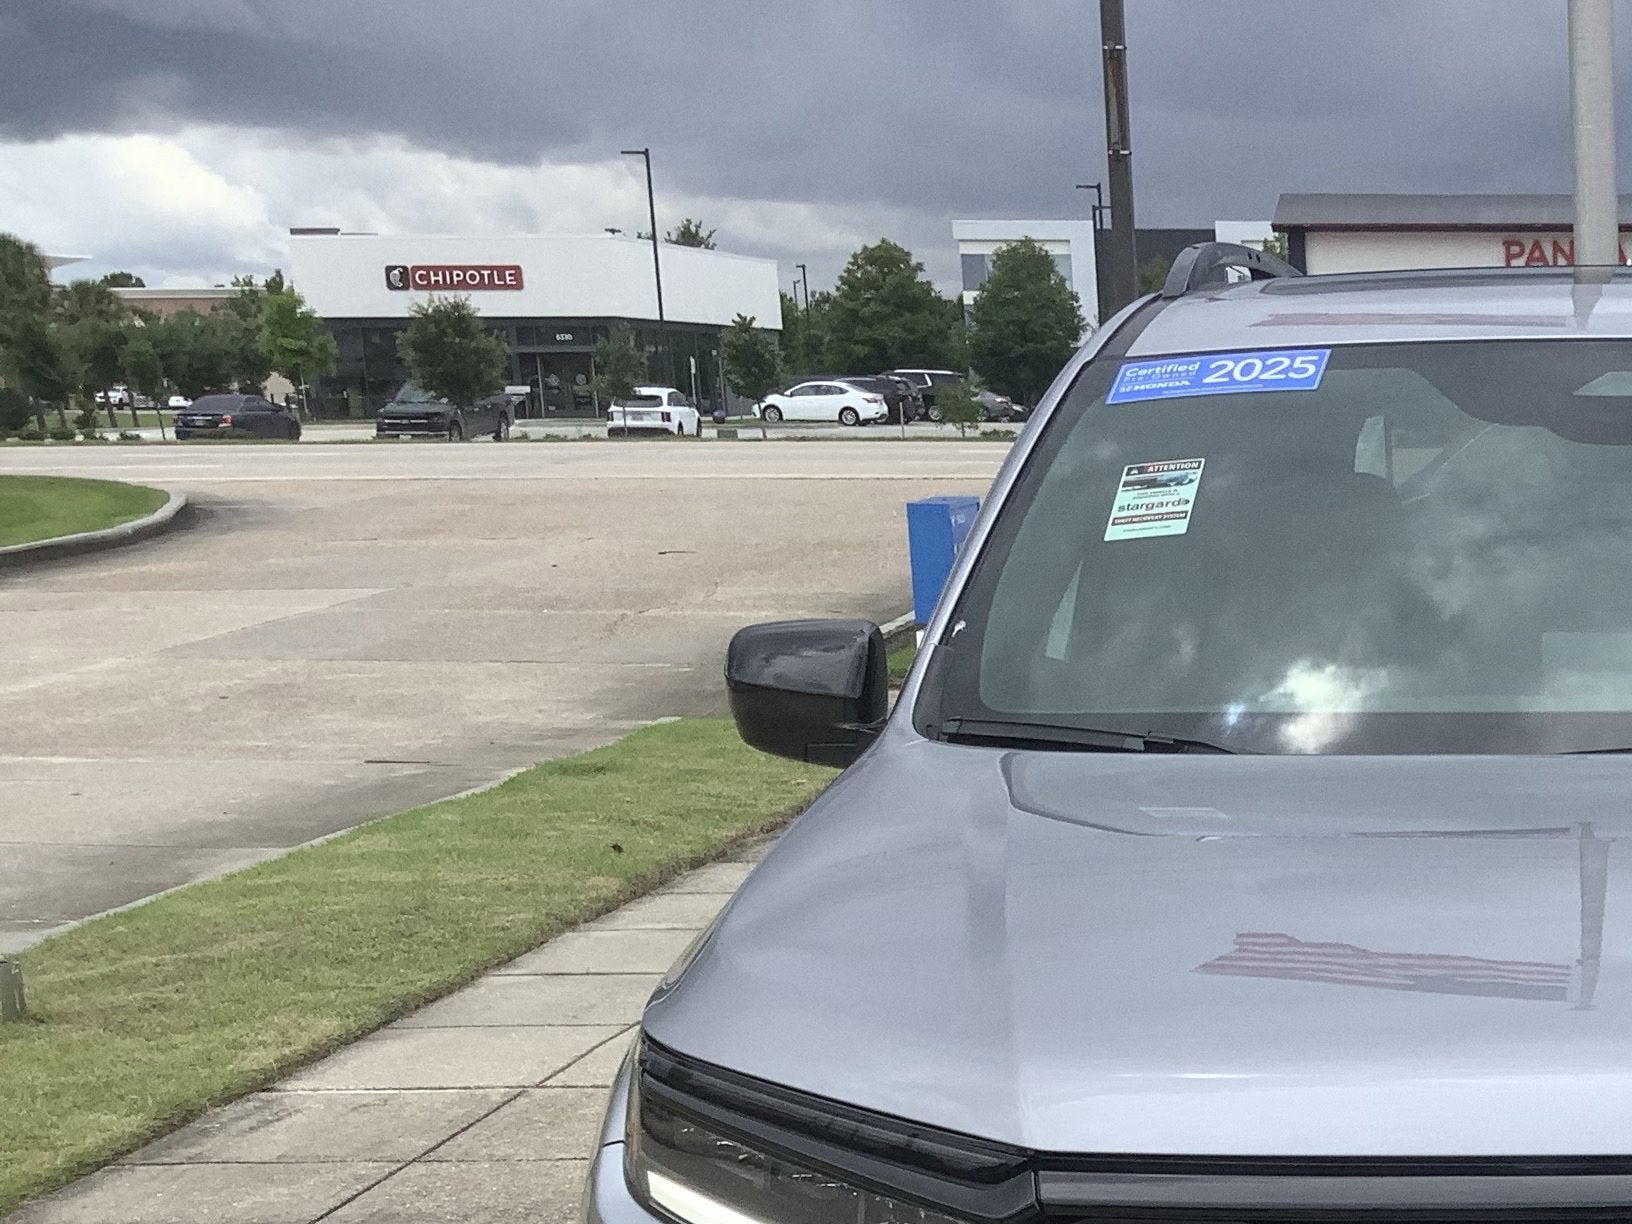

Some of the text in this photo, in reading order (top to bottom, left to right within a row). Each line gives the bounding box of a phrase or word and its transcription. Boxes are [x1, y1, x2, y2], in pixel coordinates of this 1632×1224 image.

[415, 270, 517, 285] CHIPOTLE
[1126, 362, 1200, 377] Certified
[1203, 356, 1319, 383] 2025
[1133, 380, 1190, 391] HONDA
[1147, 461, 1199, 473] ATTENTION
